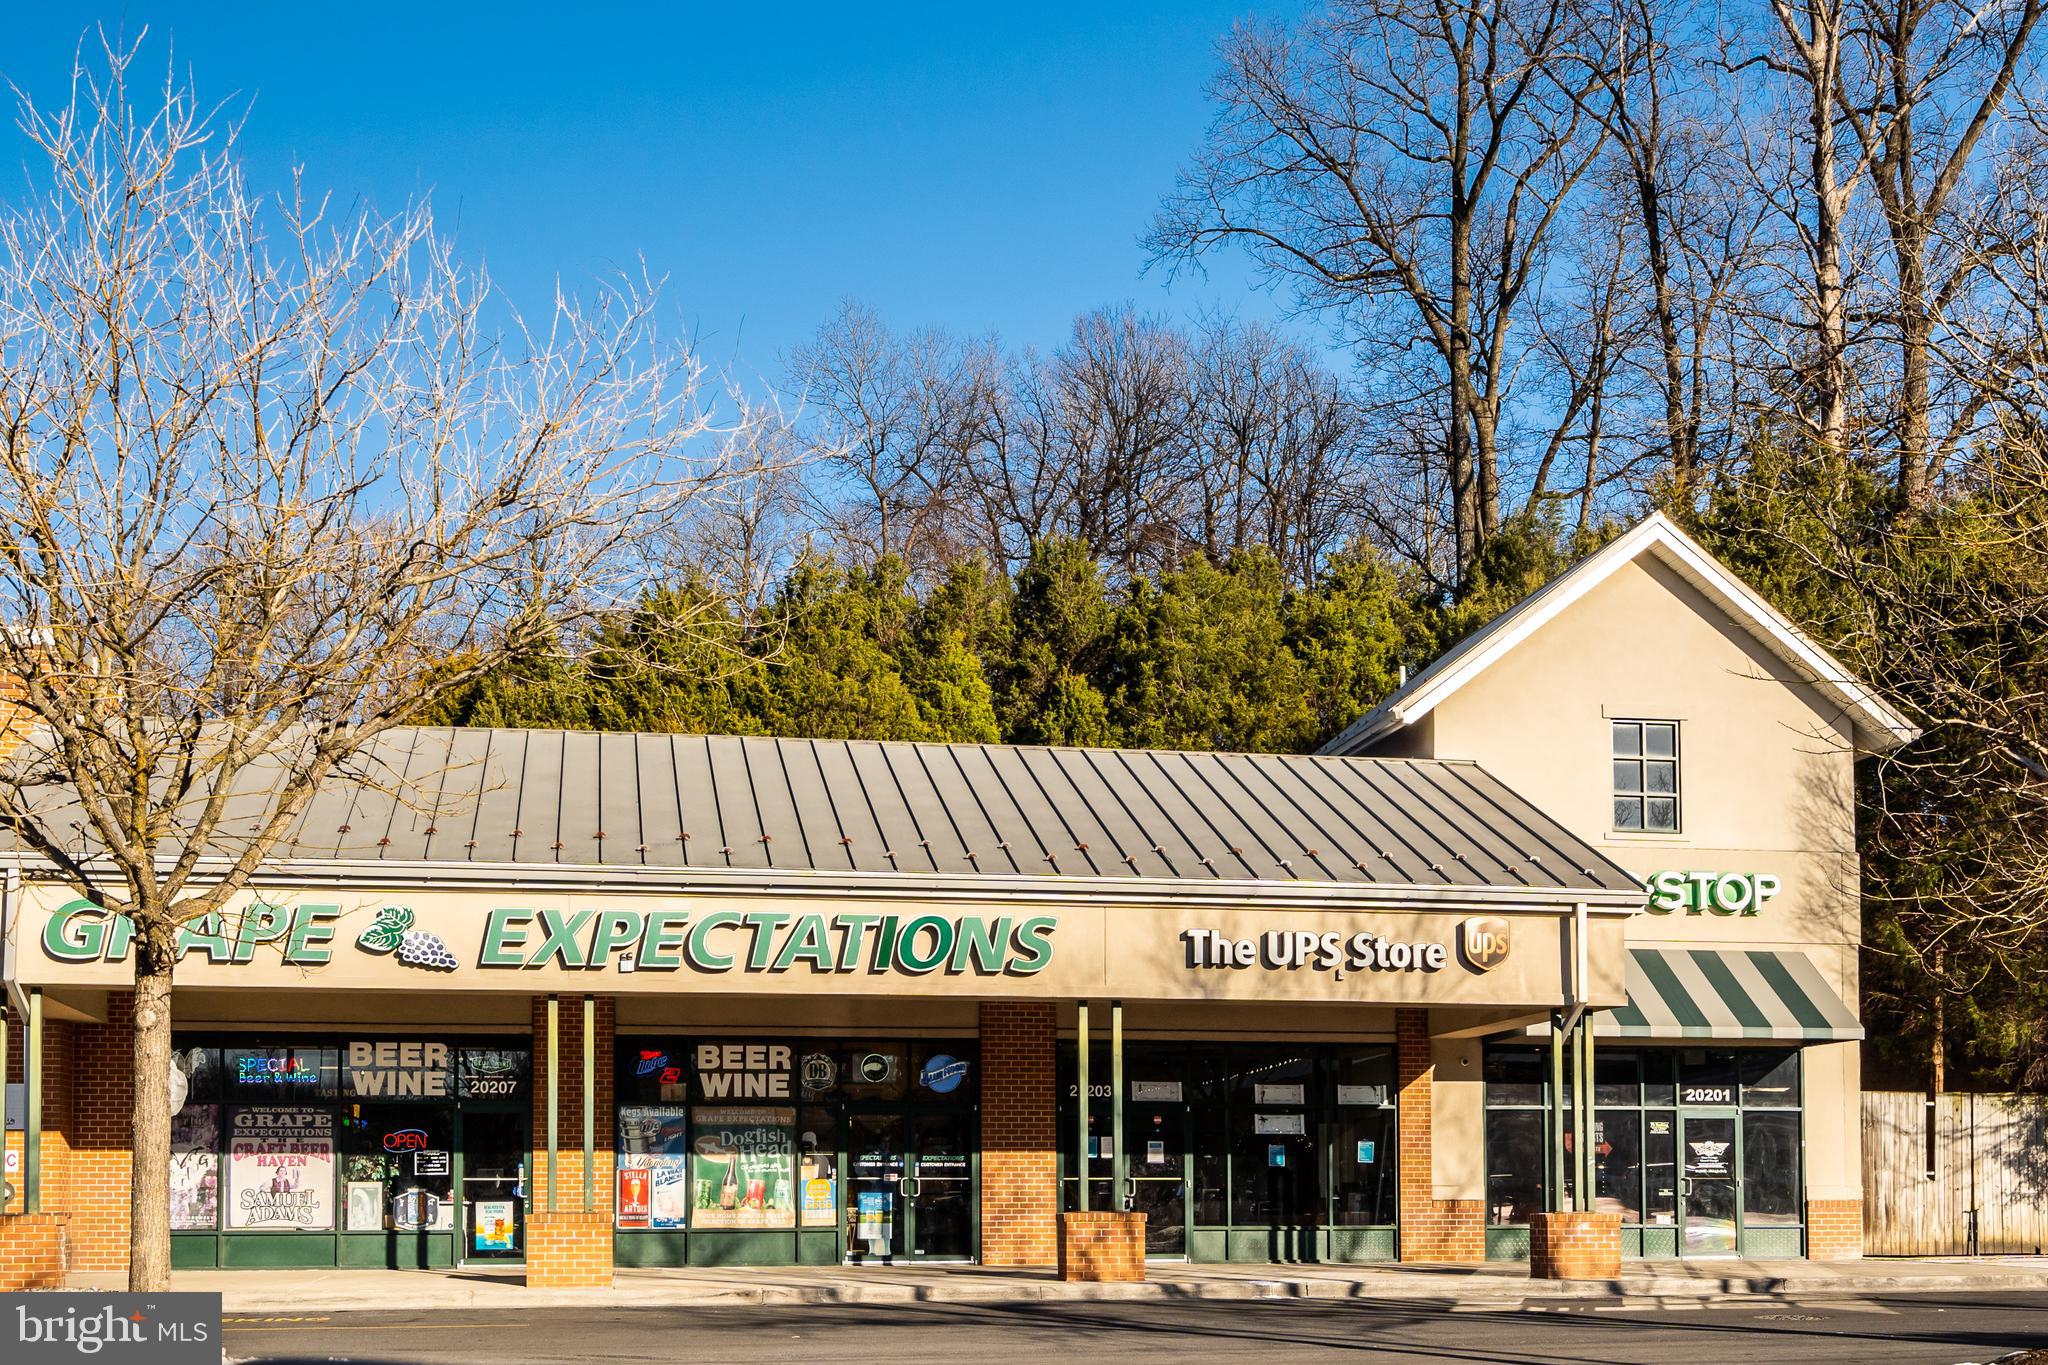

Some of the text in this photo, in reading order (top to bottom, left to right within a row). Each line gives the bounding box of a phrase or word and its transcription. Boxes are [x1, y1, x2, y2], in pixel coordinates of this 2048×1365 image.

[478, 906, 1059, 975] EXPECTATIONS
[1469, 924, 1508, 962] ups
[1186, 929, 1448, 969] The UPS Store
[349, 1042, 448, 1067] BEER
[698, 1045, 791, 1070] BEER
[239, 1056, 311, 1073] SPECIAL
[809, 1063, 827, 1079] DB
[239, 1072, 318, 1083] Beer & Wine
[351, 1071, 446, 1096] WINE
[700, 1073, 790, 1098] WINE
[314, 1089, 356, 1098] TASTNG
[470, 1081, 517, 1094] 20207
[1070, 1085, 1112, 1097] 2203
[1685, 1088, 1730, 1102] 20201
[621, 1106, 684, 1118] Kegs Available
[234, 1114, 332, 1127] GRAPE
[234, 1128, 332, 1136] EXPECTATIONS
[721, 1128, 786, 1147] Dogfish
[383, 1133, 427, 1149] OPEN
[234, 1142, 331, 1163] CRAFT BEER
[741, 1141, 792, 1161] Head
[257, 1155, 307, 1167] HAVEN
[624, 1171, 647, 1180] STELLA
[240, 1189, 320, 1210] SAMUEL
[245, 1206, 314, 1226] ADAMS
[624, 1204, 648, 1213] ARTOIS
